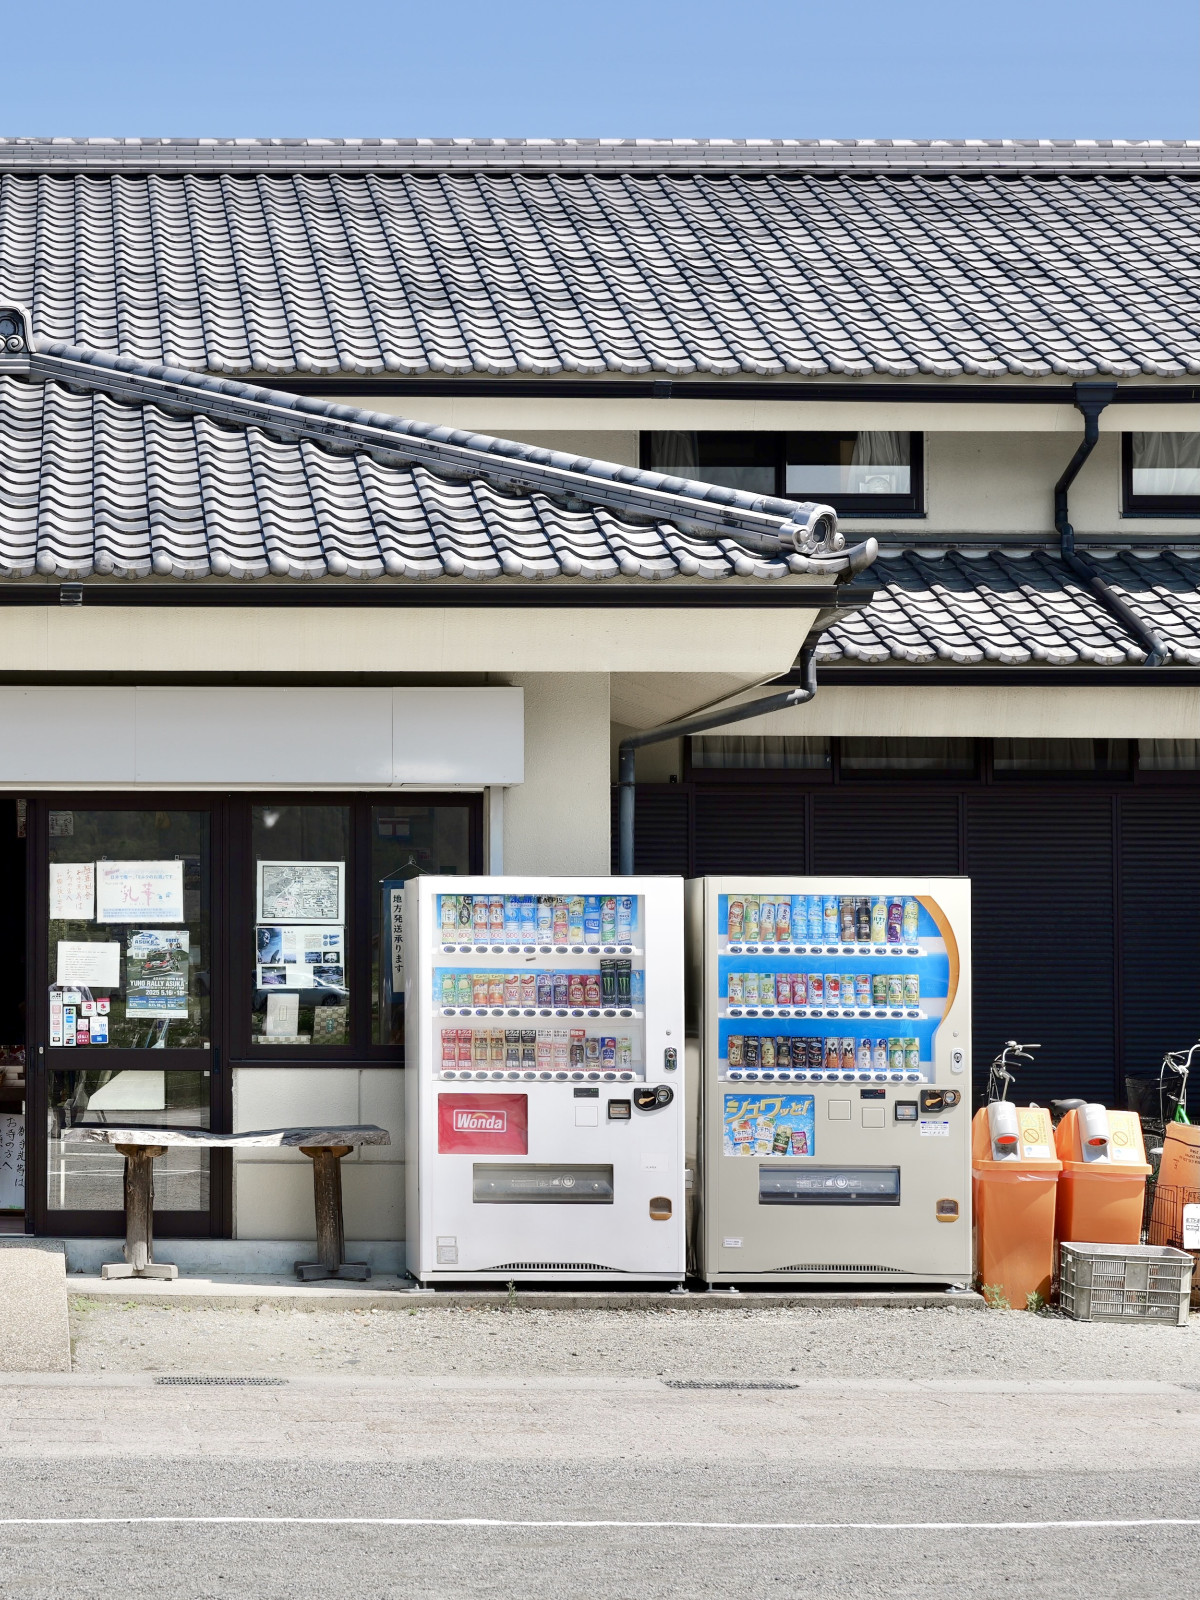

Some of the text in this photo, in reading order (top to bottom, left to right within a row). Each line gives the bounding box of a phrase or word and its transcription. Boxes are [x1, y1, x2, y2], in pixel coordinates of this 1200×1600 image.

[392, 894, 404, 973] 地方発送承ります
[2, 1117, 17, 1170] お寺の方へ
[457, 1113, 503, 1129] Wonda
